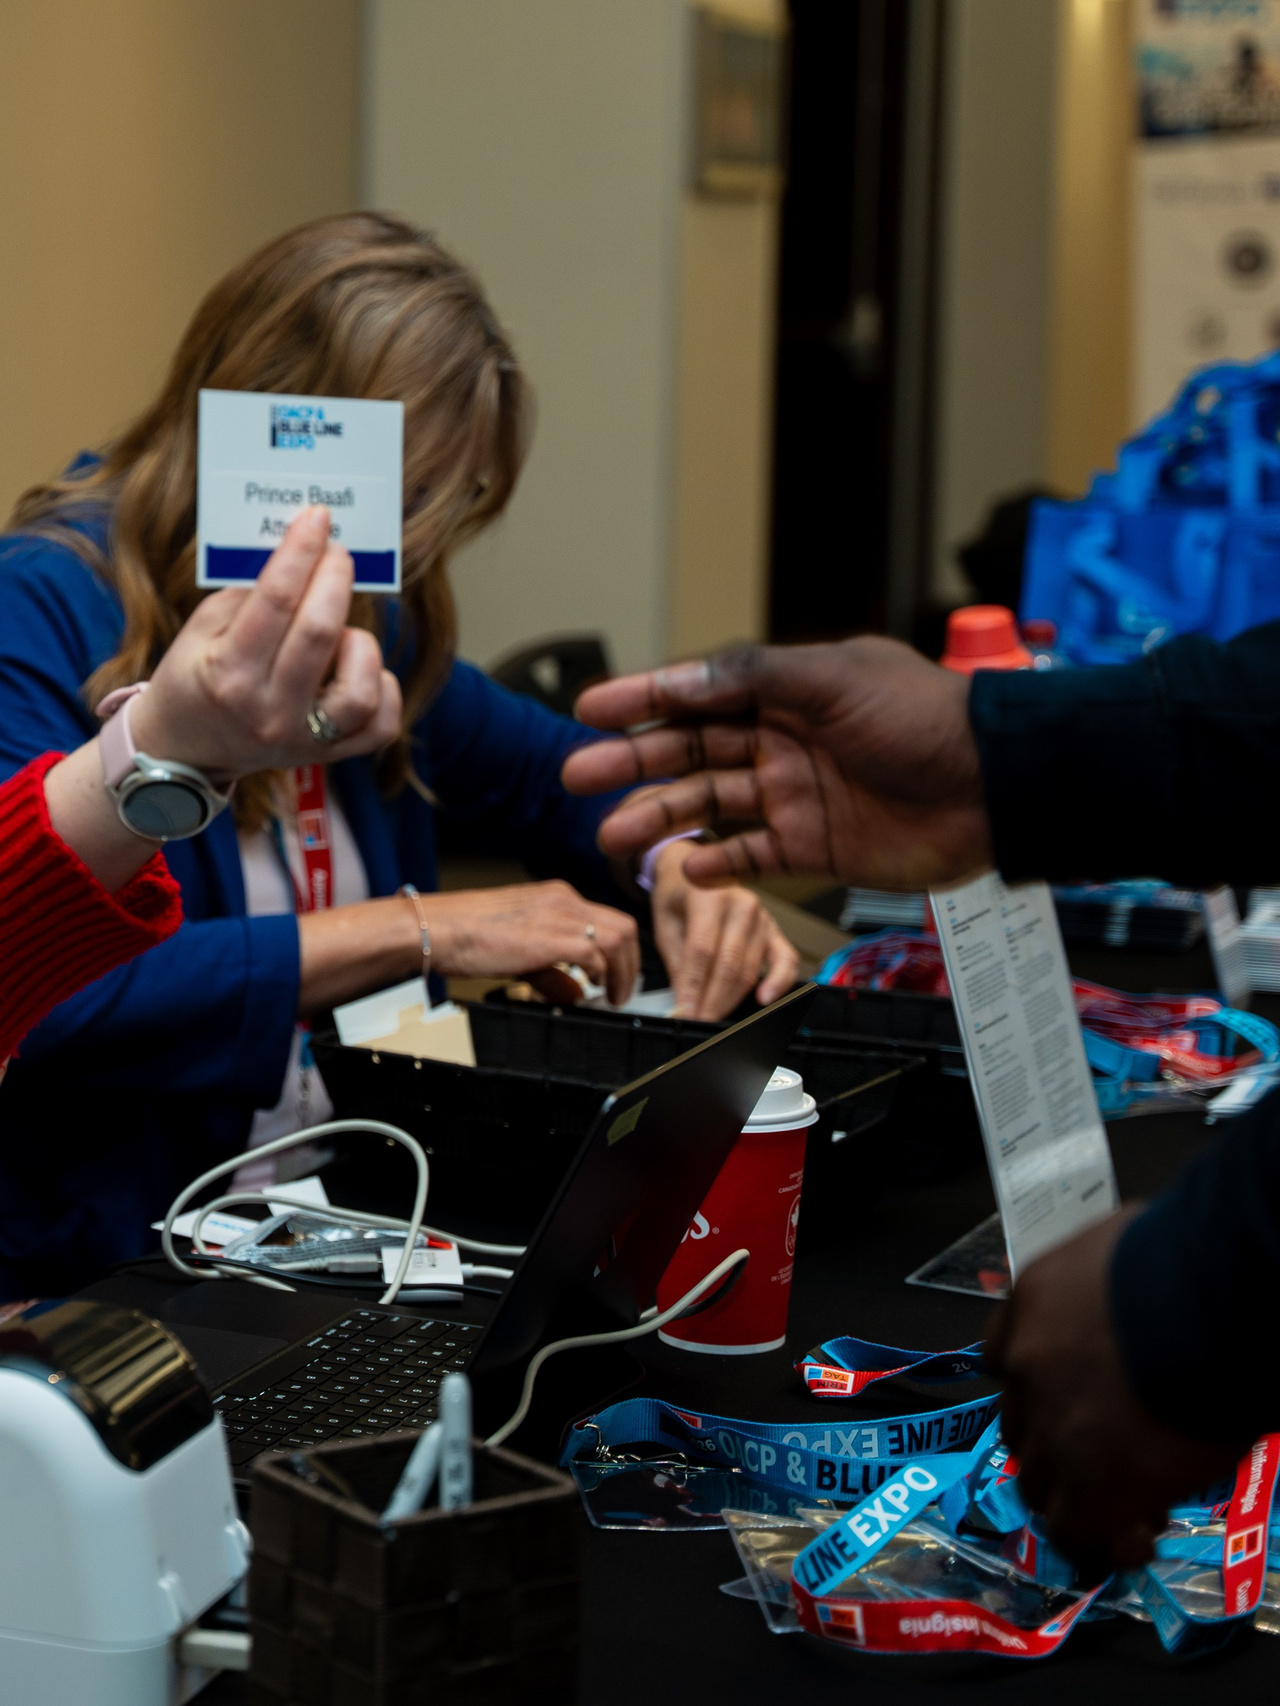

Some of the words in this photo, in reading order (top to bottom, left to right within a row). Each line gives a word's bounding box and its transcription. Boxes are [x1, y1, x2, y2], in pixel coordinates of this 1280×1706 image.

[314, 421, 343, 436] LINE
[244, 482, 304, 505] Prince
[308, 485, 355, 507] Baafi
[816, 1380, 846, 1390] TRIM
[824, 1371, 847, 1382] TAG
[888, 1417, 944, 1455] LINE
[786, 1451, 807, 1486] &
[800, 1531, 858, 1593] LINE
[847, 1466, 938, 1548] EXPO
[899, 1612, 981, 1637] Insignia
